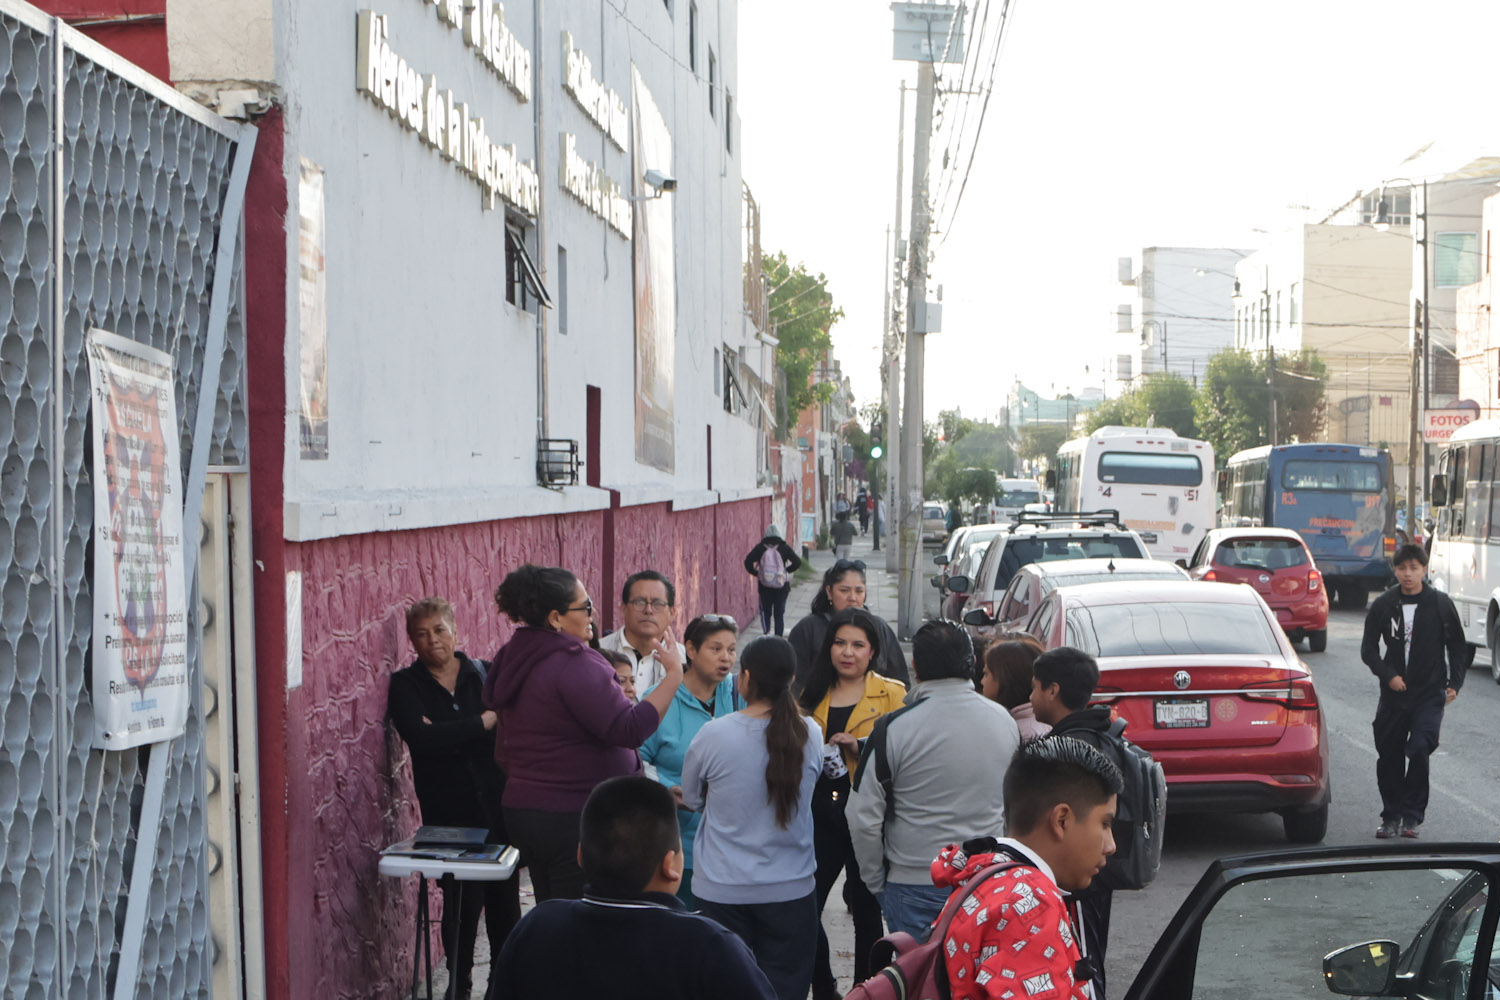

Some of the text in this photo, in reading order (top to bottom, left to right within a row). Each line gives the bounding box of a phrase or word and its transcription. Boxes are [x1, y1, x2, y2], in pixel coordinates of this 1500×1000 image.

[366, 10, 423, 133] Héroes
[427, 74, 445, 151] de
[448, 89, 461, 163] la
[1430, 415, 1470, 426] FOTOS
[1024, 973, 1054, 996] Duff
